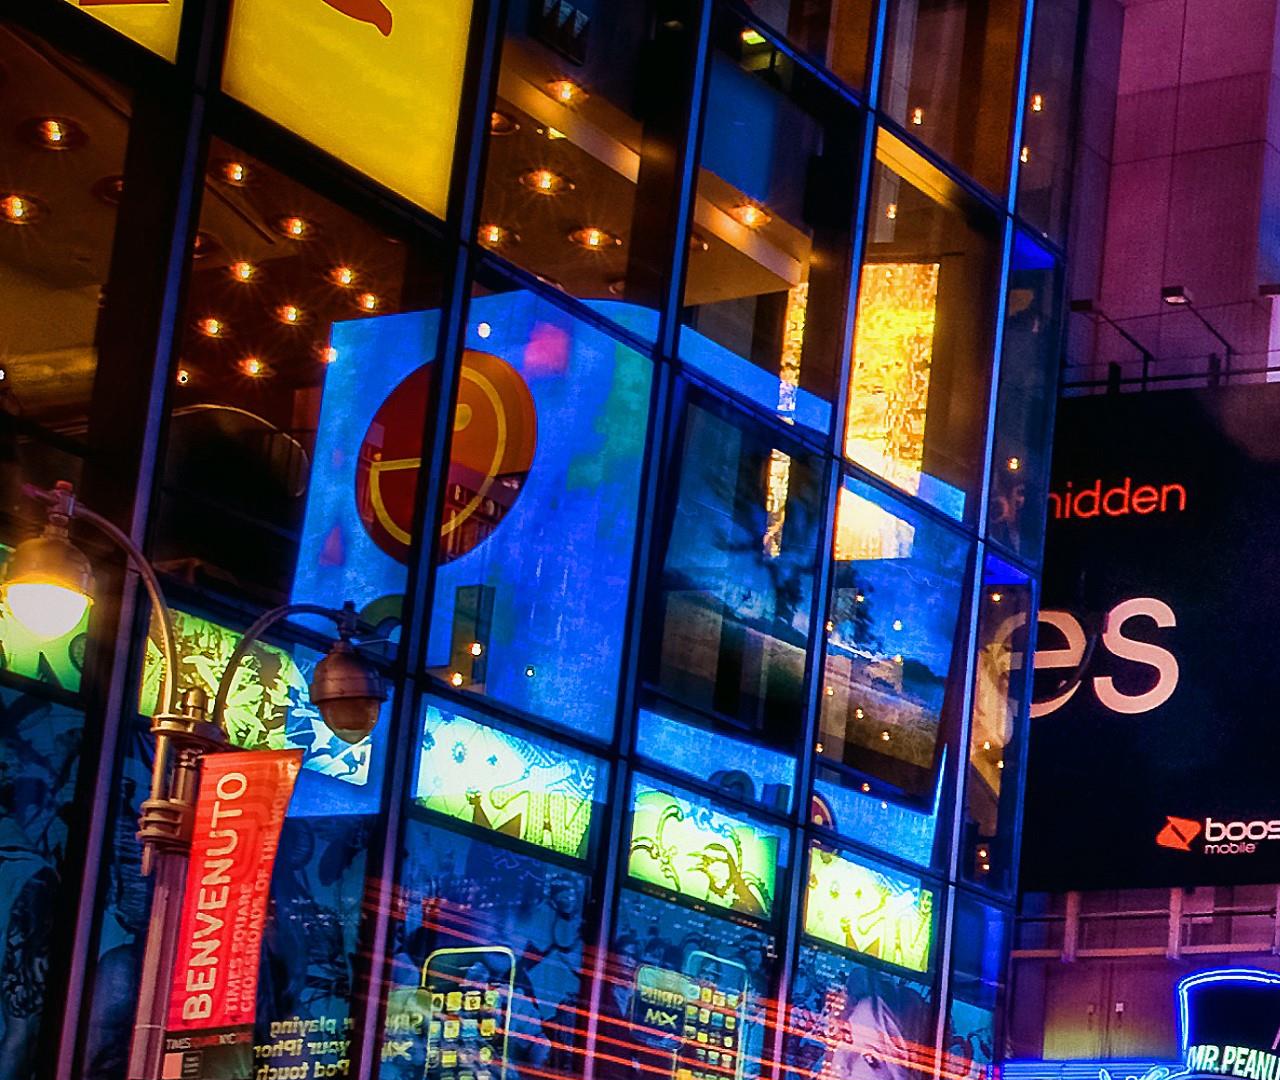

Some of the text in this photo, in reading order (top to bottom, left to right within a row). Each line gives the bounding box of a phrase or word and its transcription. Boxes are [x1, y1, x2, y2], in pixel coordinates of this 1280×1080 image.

[1204, 841, 1258, 855] mobile
[182, 771, 249, 1021] BENVENUTO
[1186, 1045, 1221, 1073] MR.
